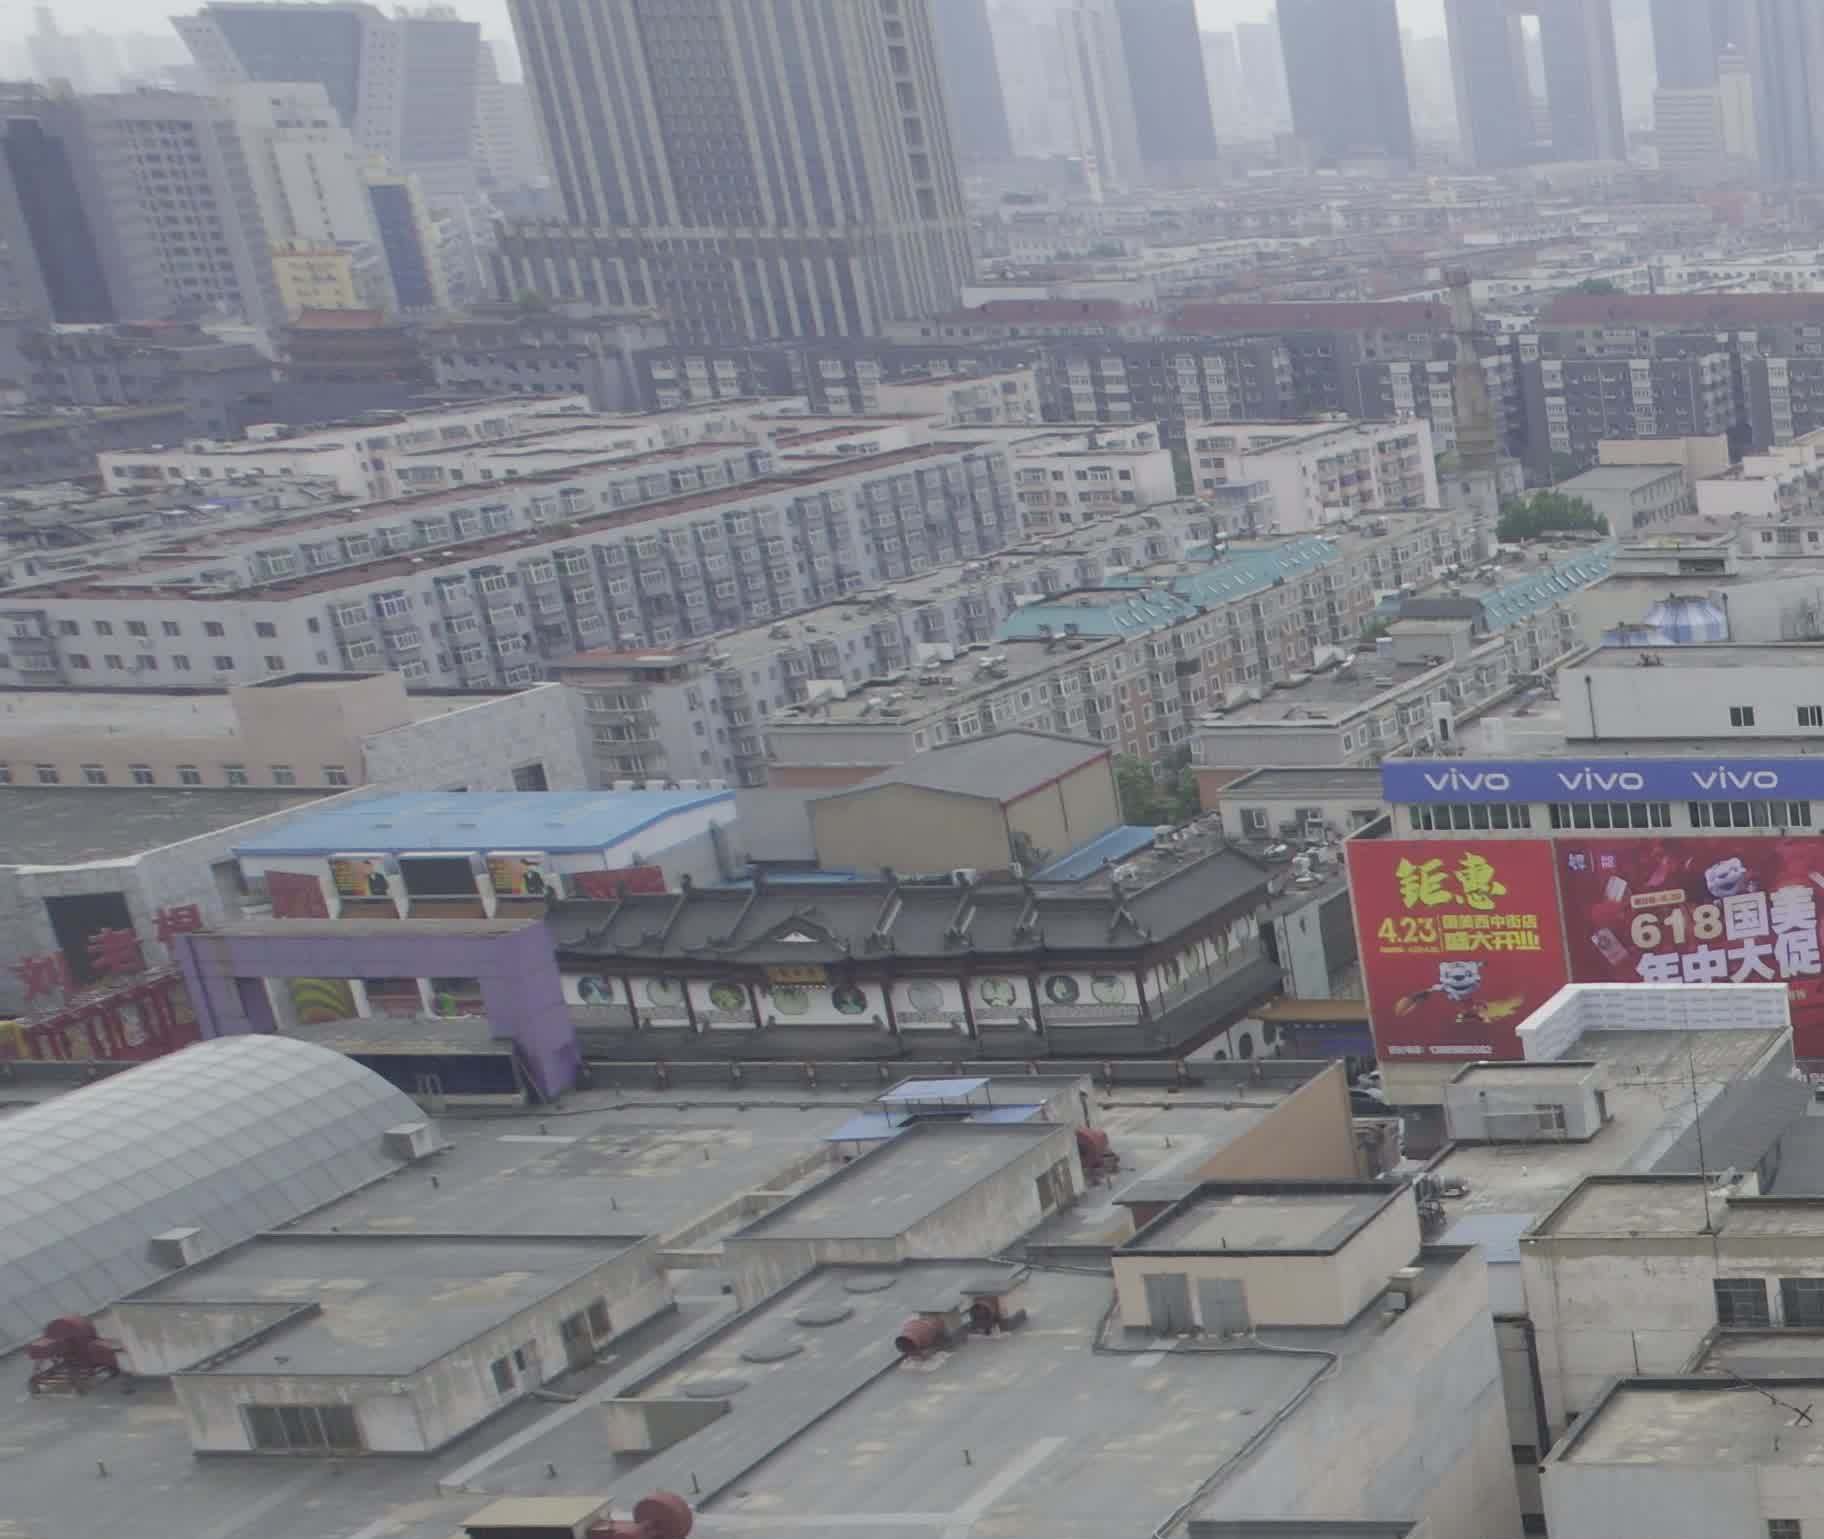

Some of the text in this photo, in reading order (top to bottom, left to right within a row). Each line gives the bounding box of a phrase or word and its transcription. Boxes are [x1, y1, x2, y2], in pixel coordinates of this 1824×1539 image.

[1424, 768, 1510, 792] vivo
[1558, 767, 1645, 791] vivo
[1692, 766, 1779, 790] vivo
[1396, 851, 1507, 910] 钜惠
[1378, 917, 1437, 943] 4.23
[1631, 885, 1817, 950] 618国美
[1444, 931, 1543, 951] 盛大开业
[1636, 932, 1823, 984] 年中大促
